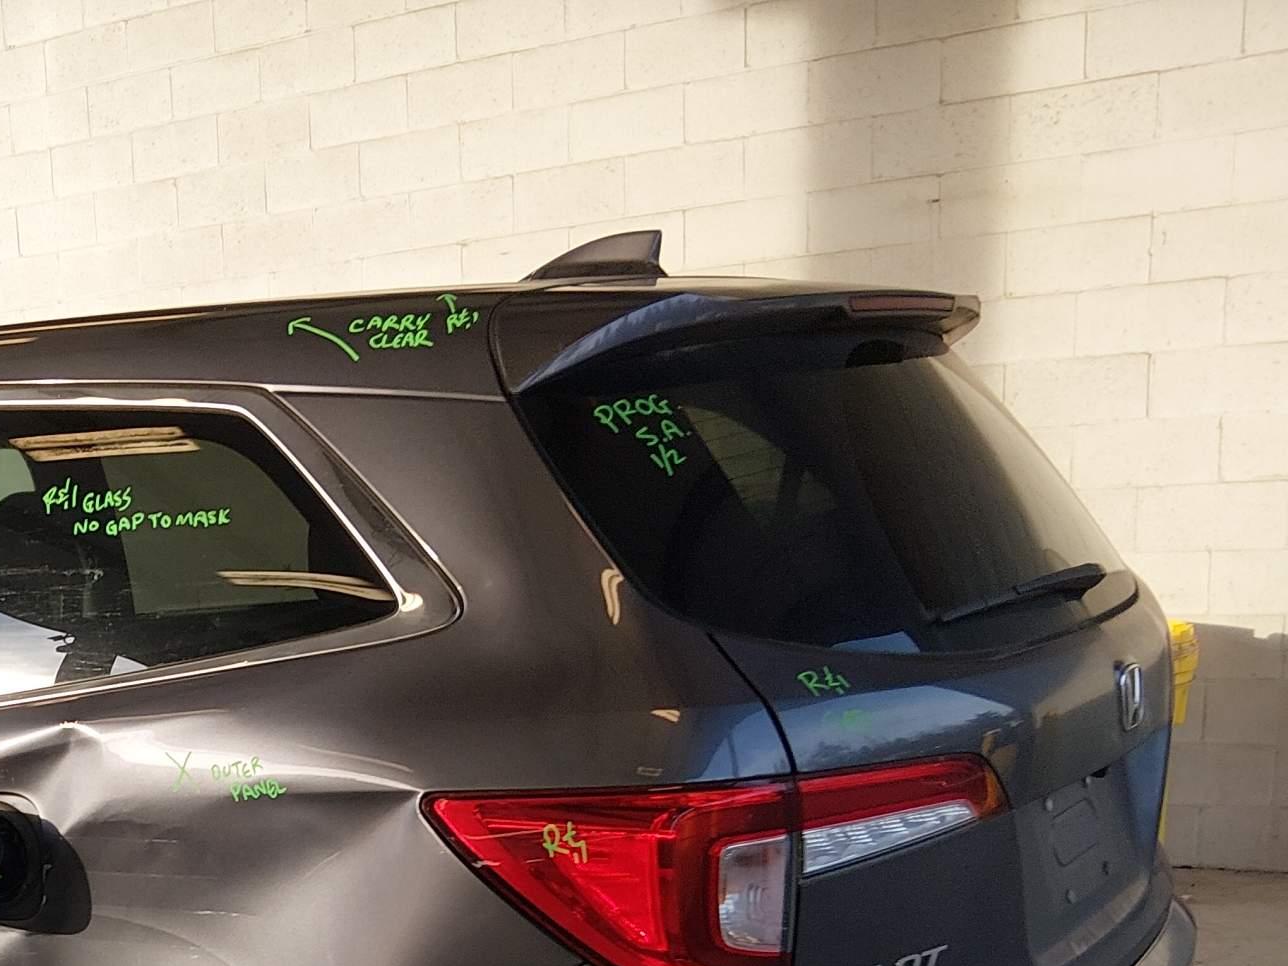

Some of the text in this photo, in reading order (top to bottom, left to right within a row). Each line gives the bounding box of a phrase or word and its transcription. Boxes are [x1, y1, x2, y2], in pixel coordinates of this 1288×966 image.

[348, 313, 431, 333] CARRY
[368, 329, 434, 348] CLEAR
[593, 394, 673, 433] PROG
[650, 444, 687, 476] 1/2
[82, 486, 132, 513] GLASS
[73, 508, 231, 537] NO GAP TO MASK
[211, 756, 263, 780] OUTER
[230, 779, 288, 802] PANEL
